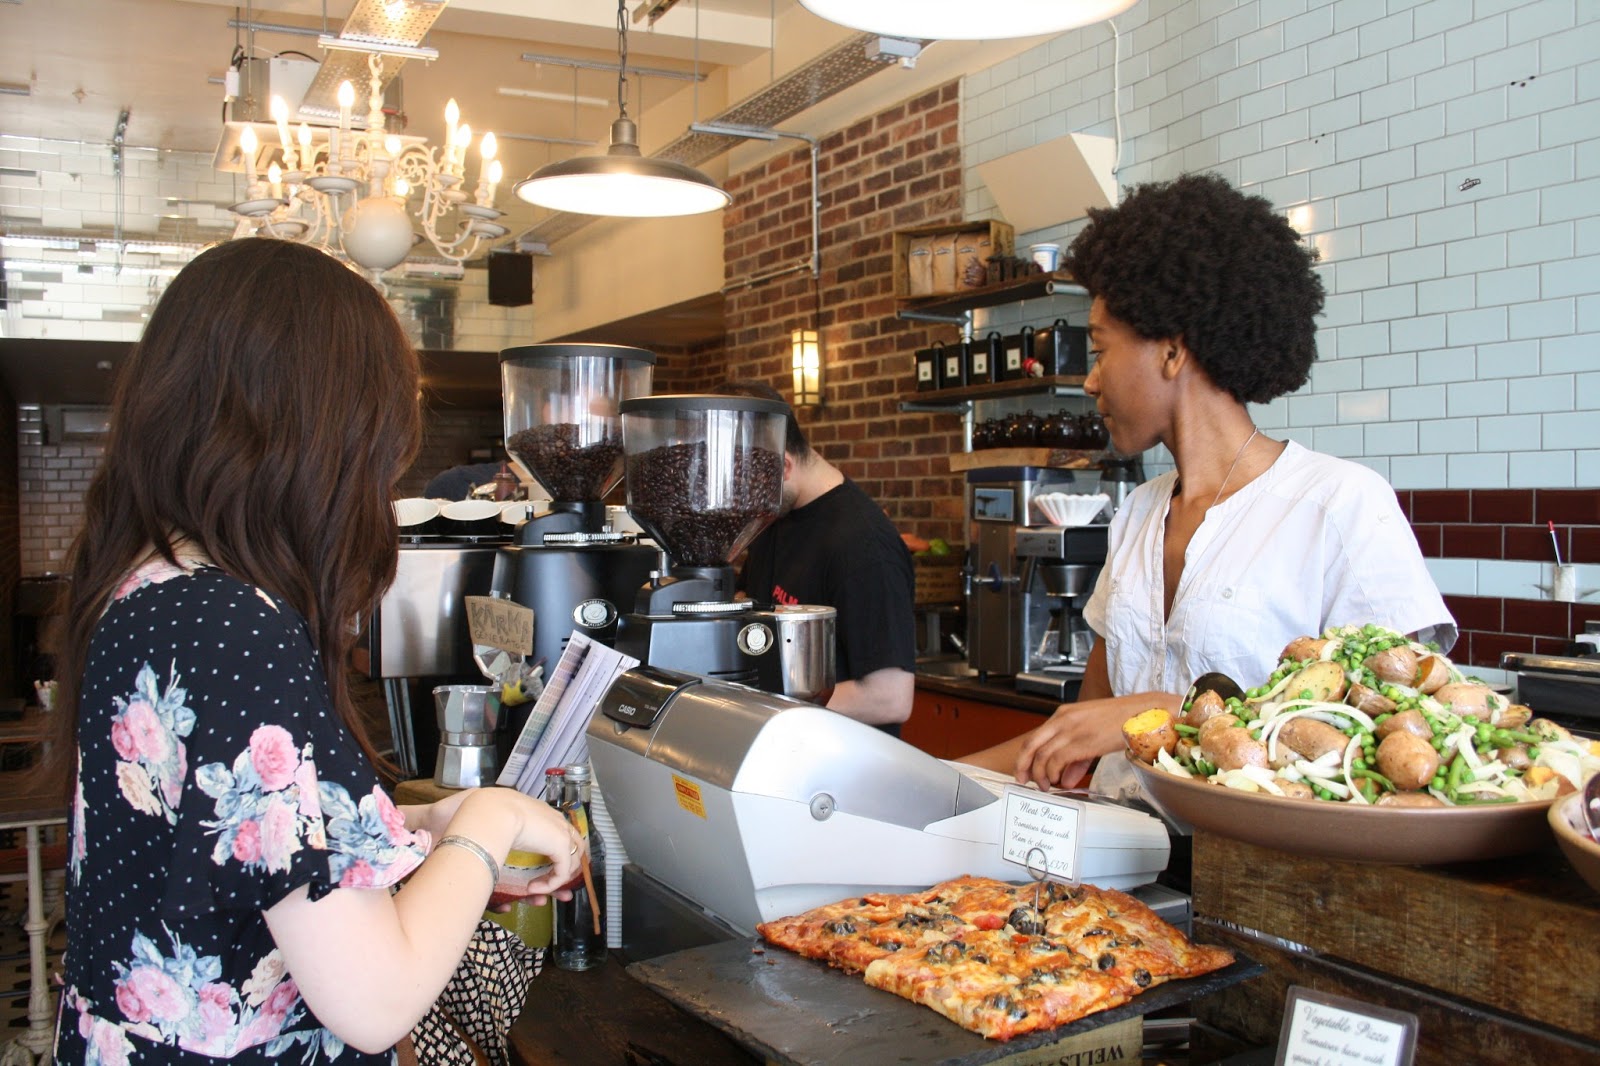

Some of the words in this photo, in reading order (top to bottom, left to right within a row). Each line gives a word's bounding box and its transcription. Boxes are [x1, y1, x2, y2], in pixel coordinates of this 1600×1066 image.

[471, 602, 530, 642] KARMA
[618, 703, 637, 716] CASIO
[1019, 801, 1039, 816] Meat
[1041, 806, 1063, 822] Pizza
[1011, 831, 1026, 843] Ham
[1028, 837, 1034, 846] &
[1035, 839, 1055, 850] cheese
[1040, 825, 1054, 835] base
[1055, 830, 1070, 840] with
[1303, 1006, 1351, 1032] Vegetable
[1354, 1020, 1390, 1044] Pizza
[1059, 1045, 1124, 1066] WELLS
[1341, 1044, 1361, 1058] base
[1363, 1053, 1385, 1065] with
